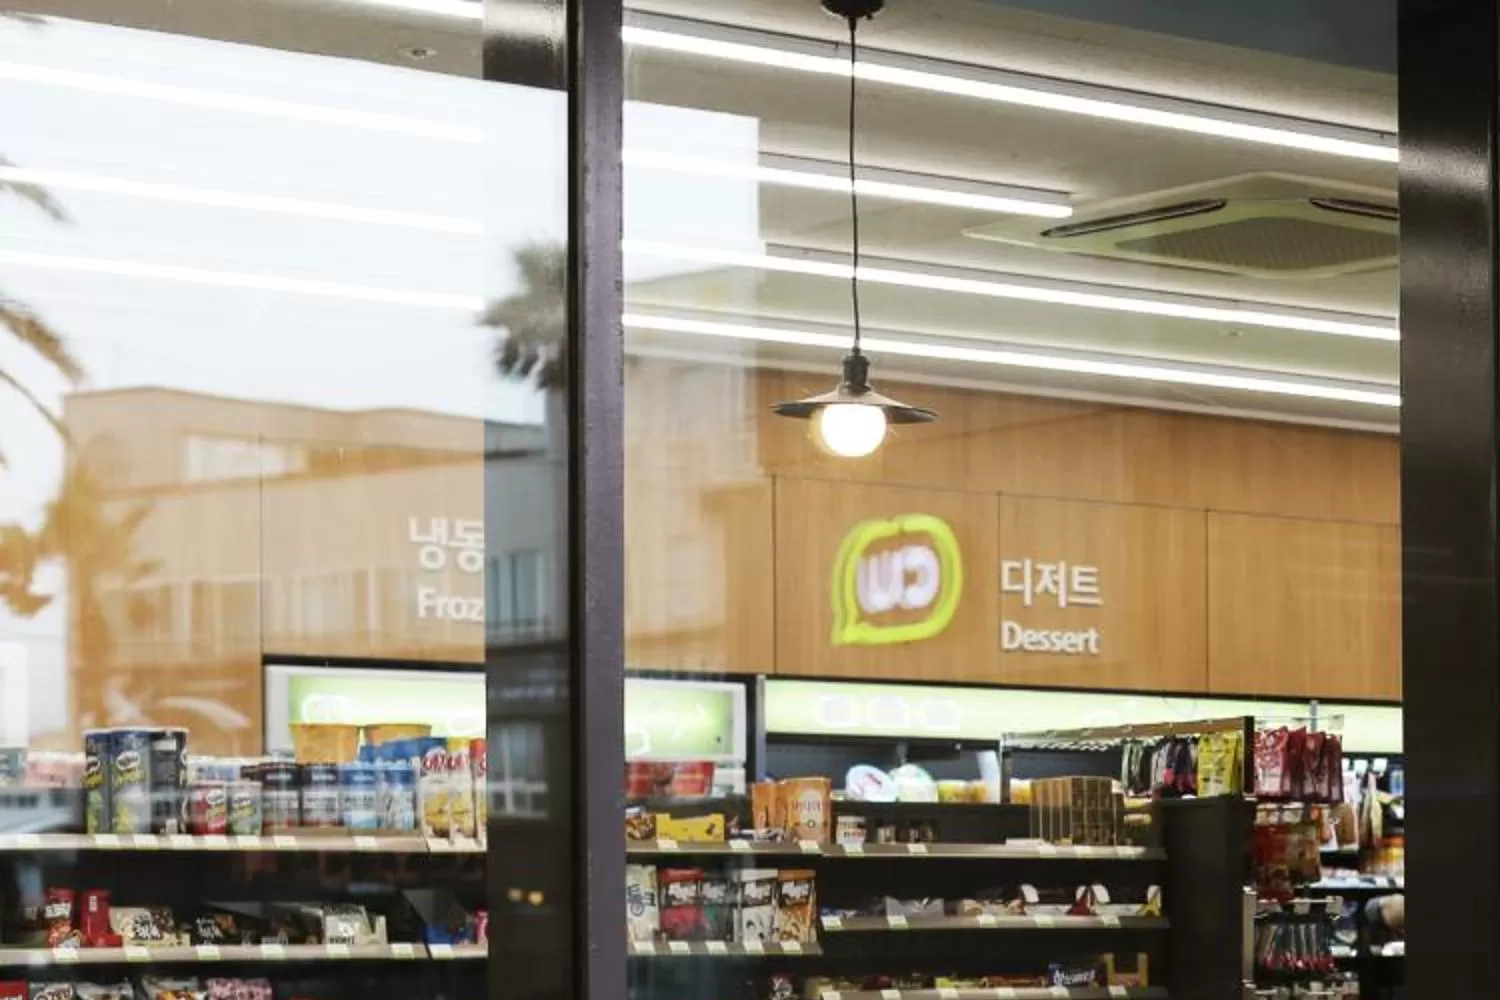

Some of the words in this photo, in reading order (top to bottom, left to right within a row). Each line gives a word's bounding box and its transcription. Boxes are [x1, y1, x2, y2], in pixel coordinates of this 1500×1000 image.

[409, 517, 485, 570] 냉동
[1002, 559, 1103, 607] 디저트
[1002, 621, 1100, 654] Dessert
